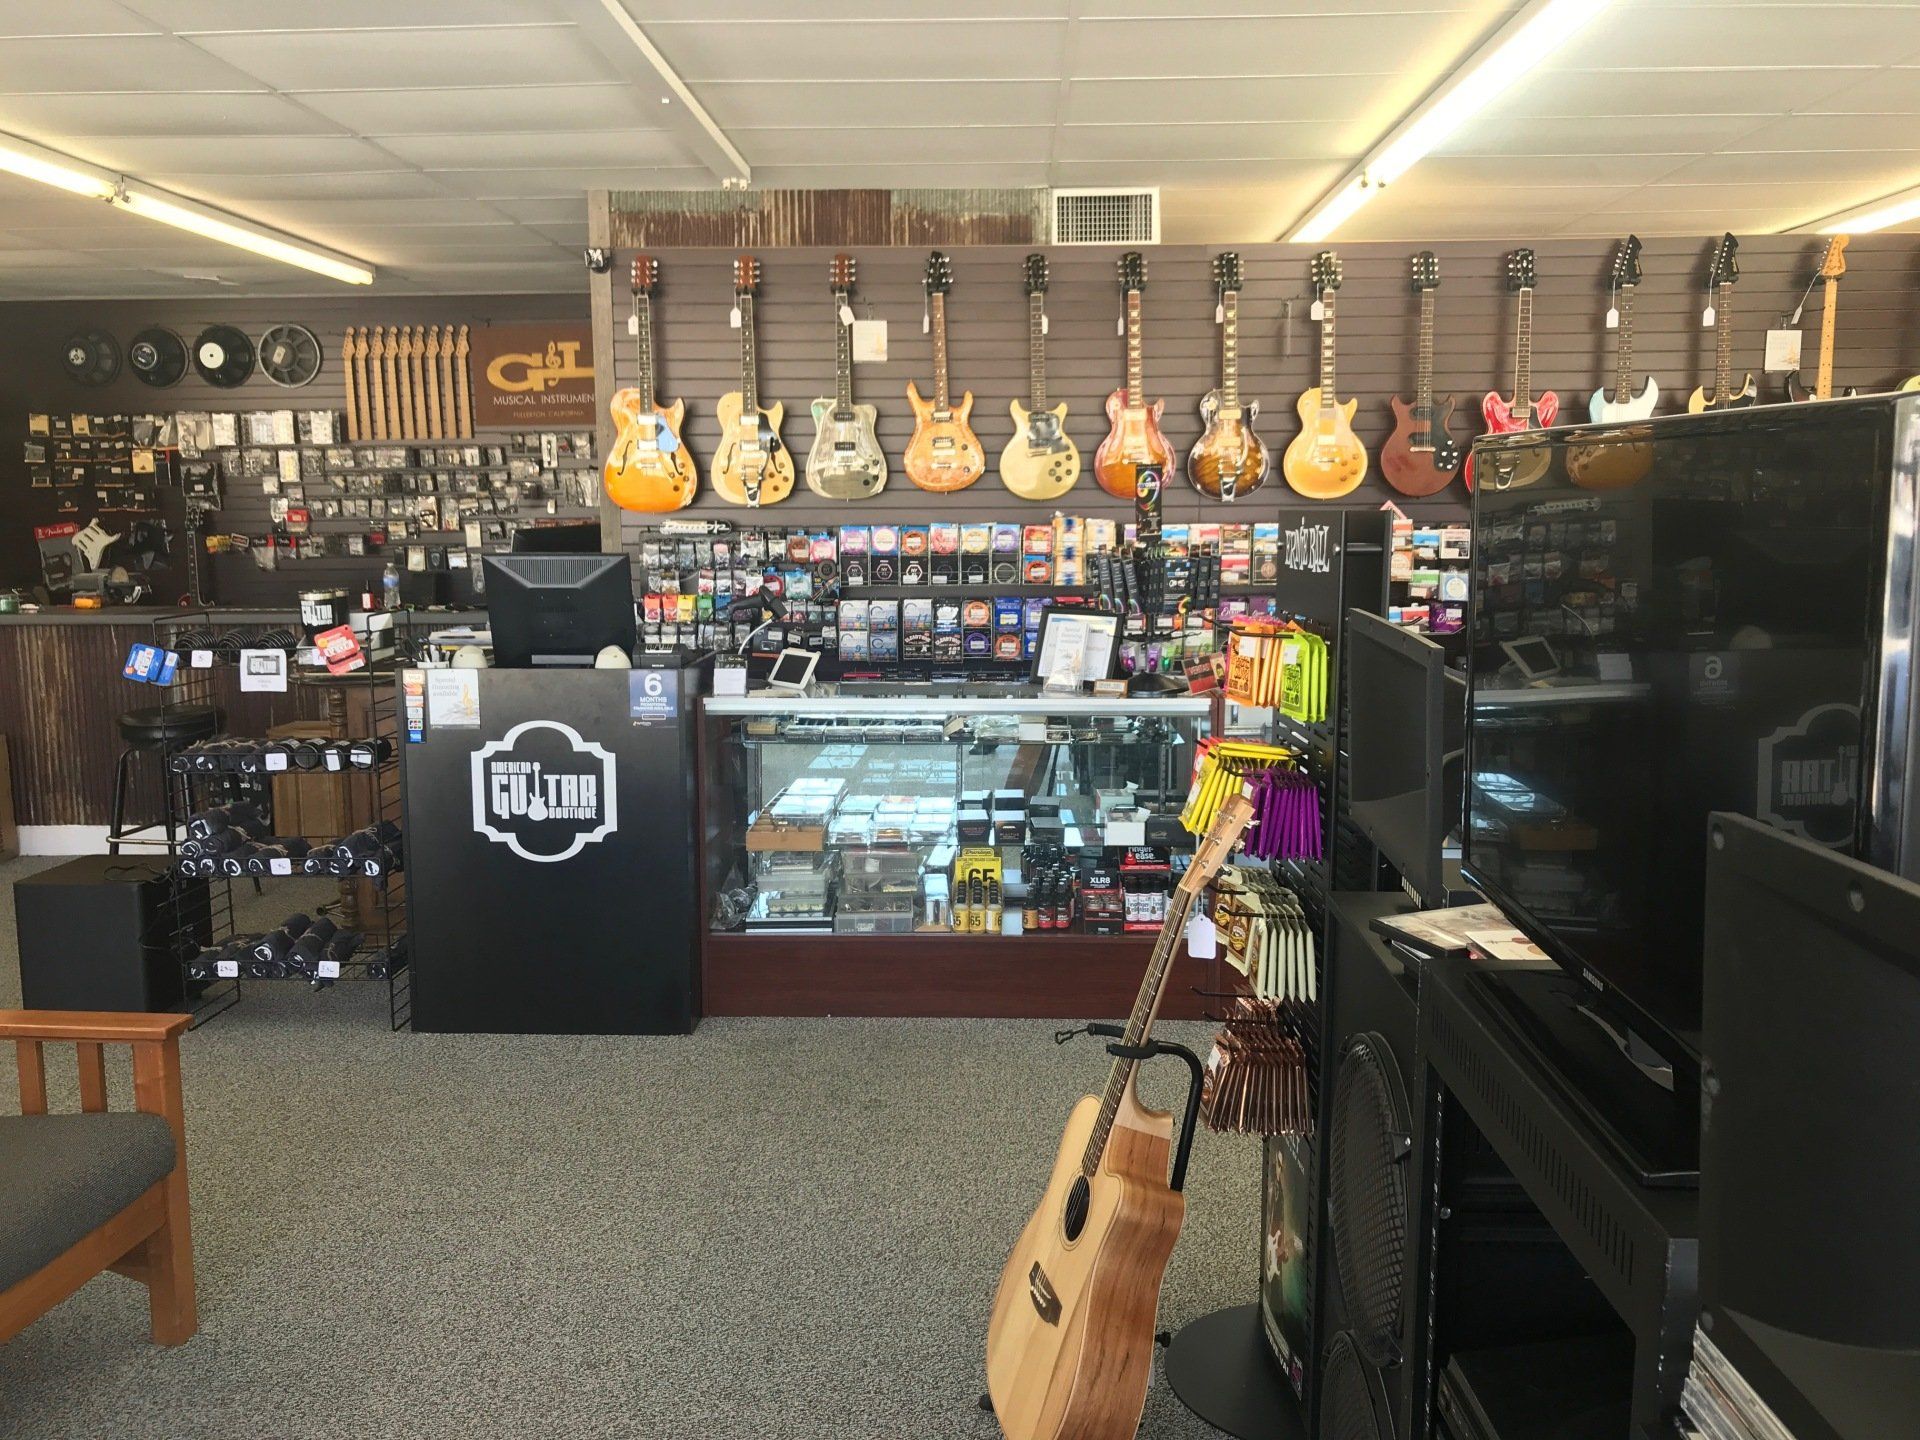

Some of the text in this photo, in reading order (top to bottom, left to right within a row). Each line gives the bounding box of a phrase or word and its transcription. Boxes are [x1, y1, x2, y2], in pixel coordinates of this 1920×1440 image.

[493, 395, 536, 406] MUSICAL
[1284, 516, 1330, 573] ERNIE BALL
[644, 673, 663, 696] 6
[490, 761, 532, 774] AMERICAN
[548, 806, 597, 820] BOUTIQUE
[1090, 876, 1111, 884] XLR8
[969, 916, 981, 927] 65
[1582, 967, 1604, 992] SAMSUNG
